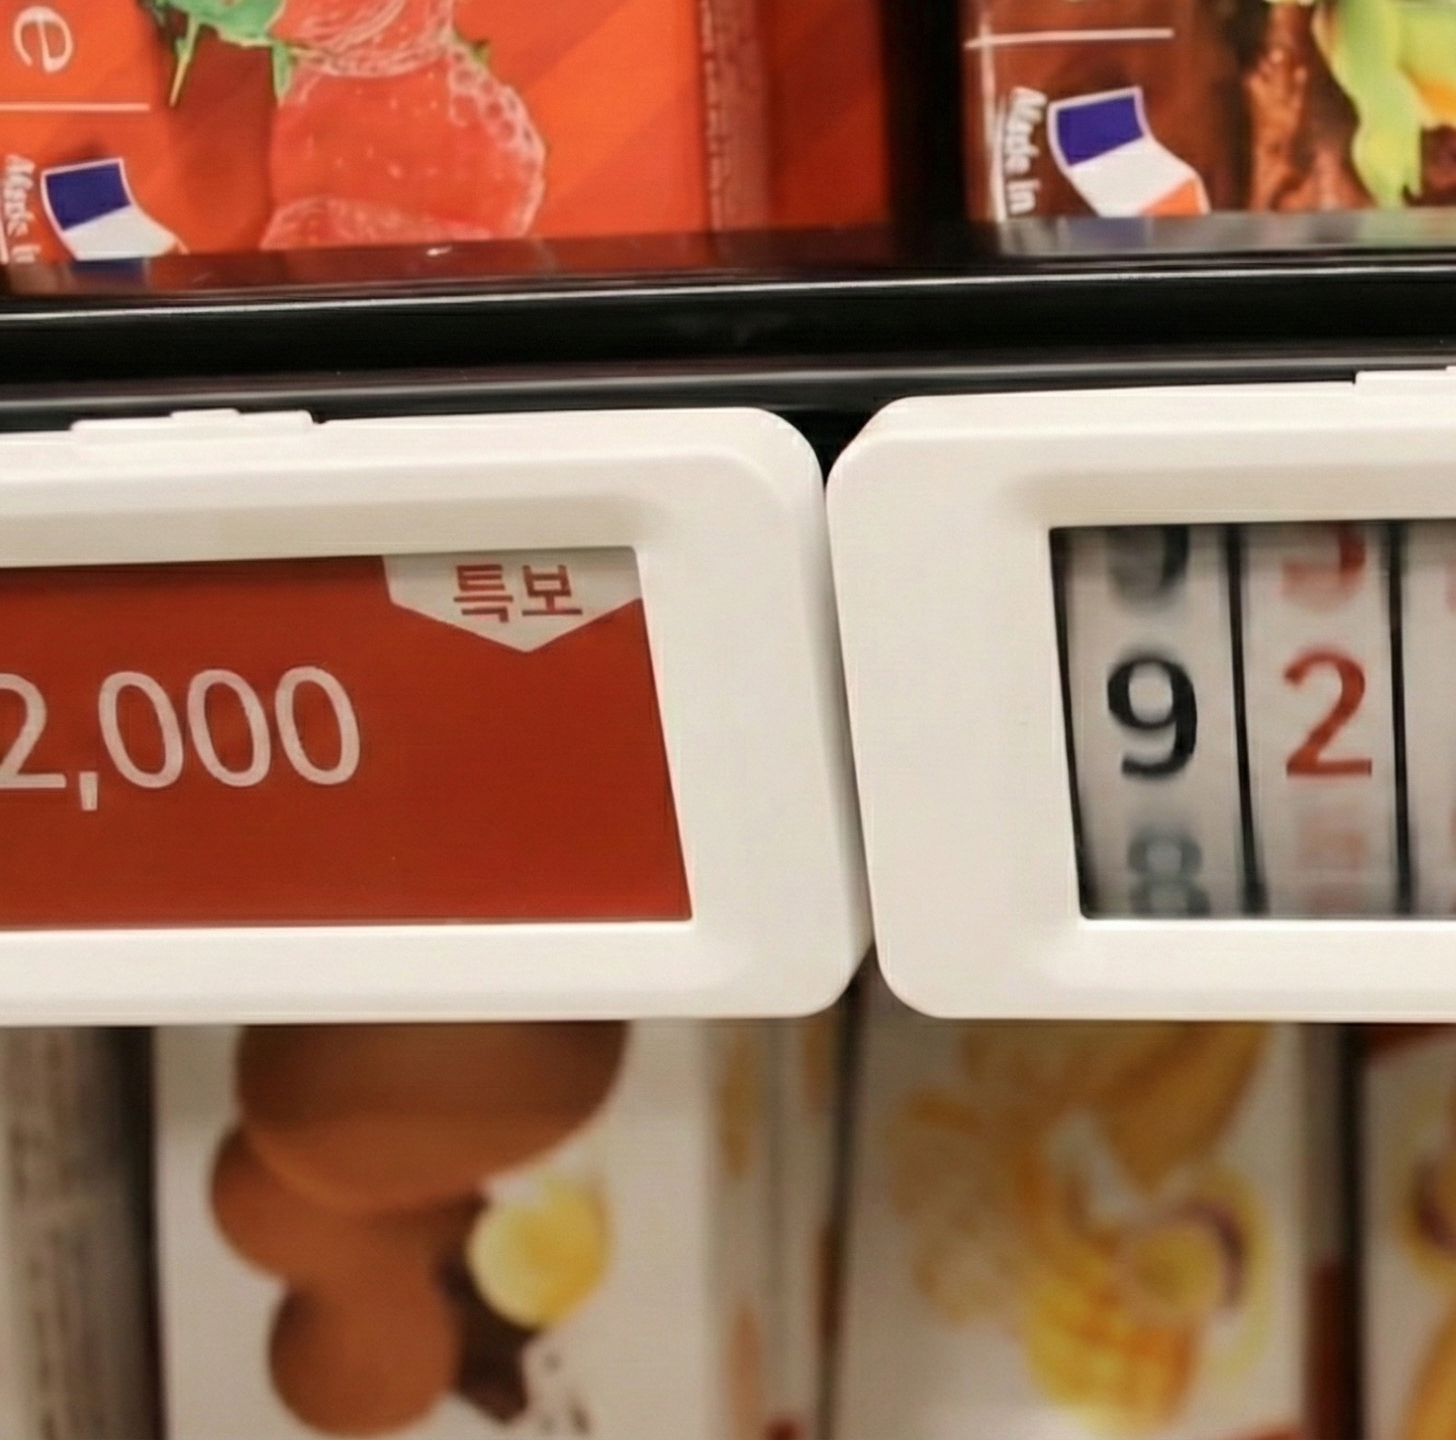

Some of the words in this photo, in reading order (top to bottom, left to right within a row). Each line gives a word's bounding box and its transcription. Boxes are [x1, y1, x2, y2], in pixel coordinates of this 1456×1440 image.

[1004, 86, 1048, 174] Made
[453, 562, 584, 624] 특보
[0, 665, 362, 811] 2,000
[1107, 646, 1198, 780] 9
[1283, 645, 1373, 778] 2
